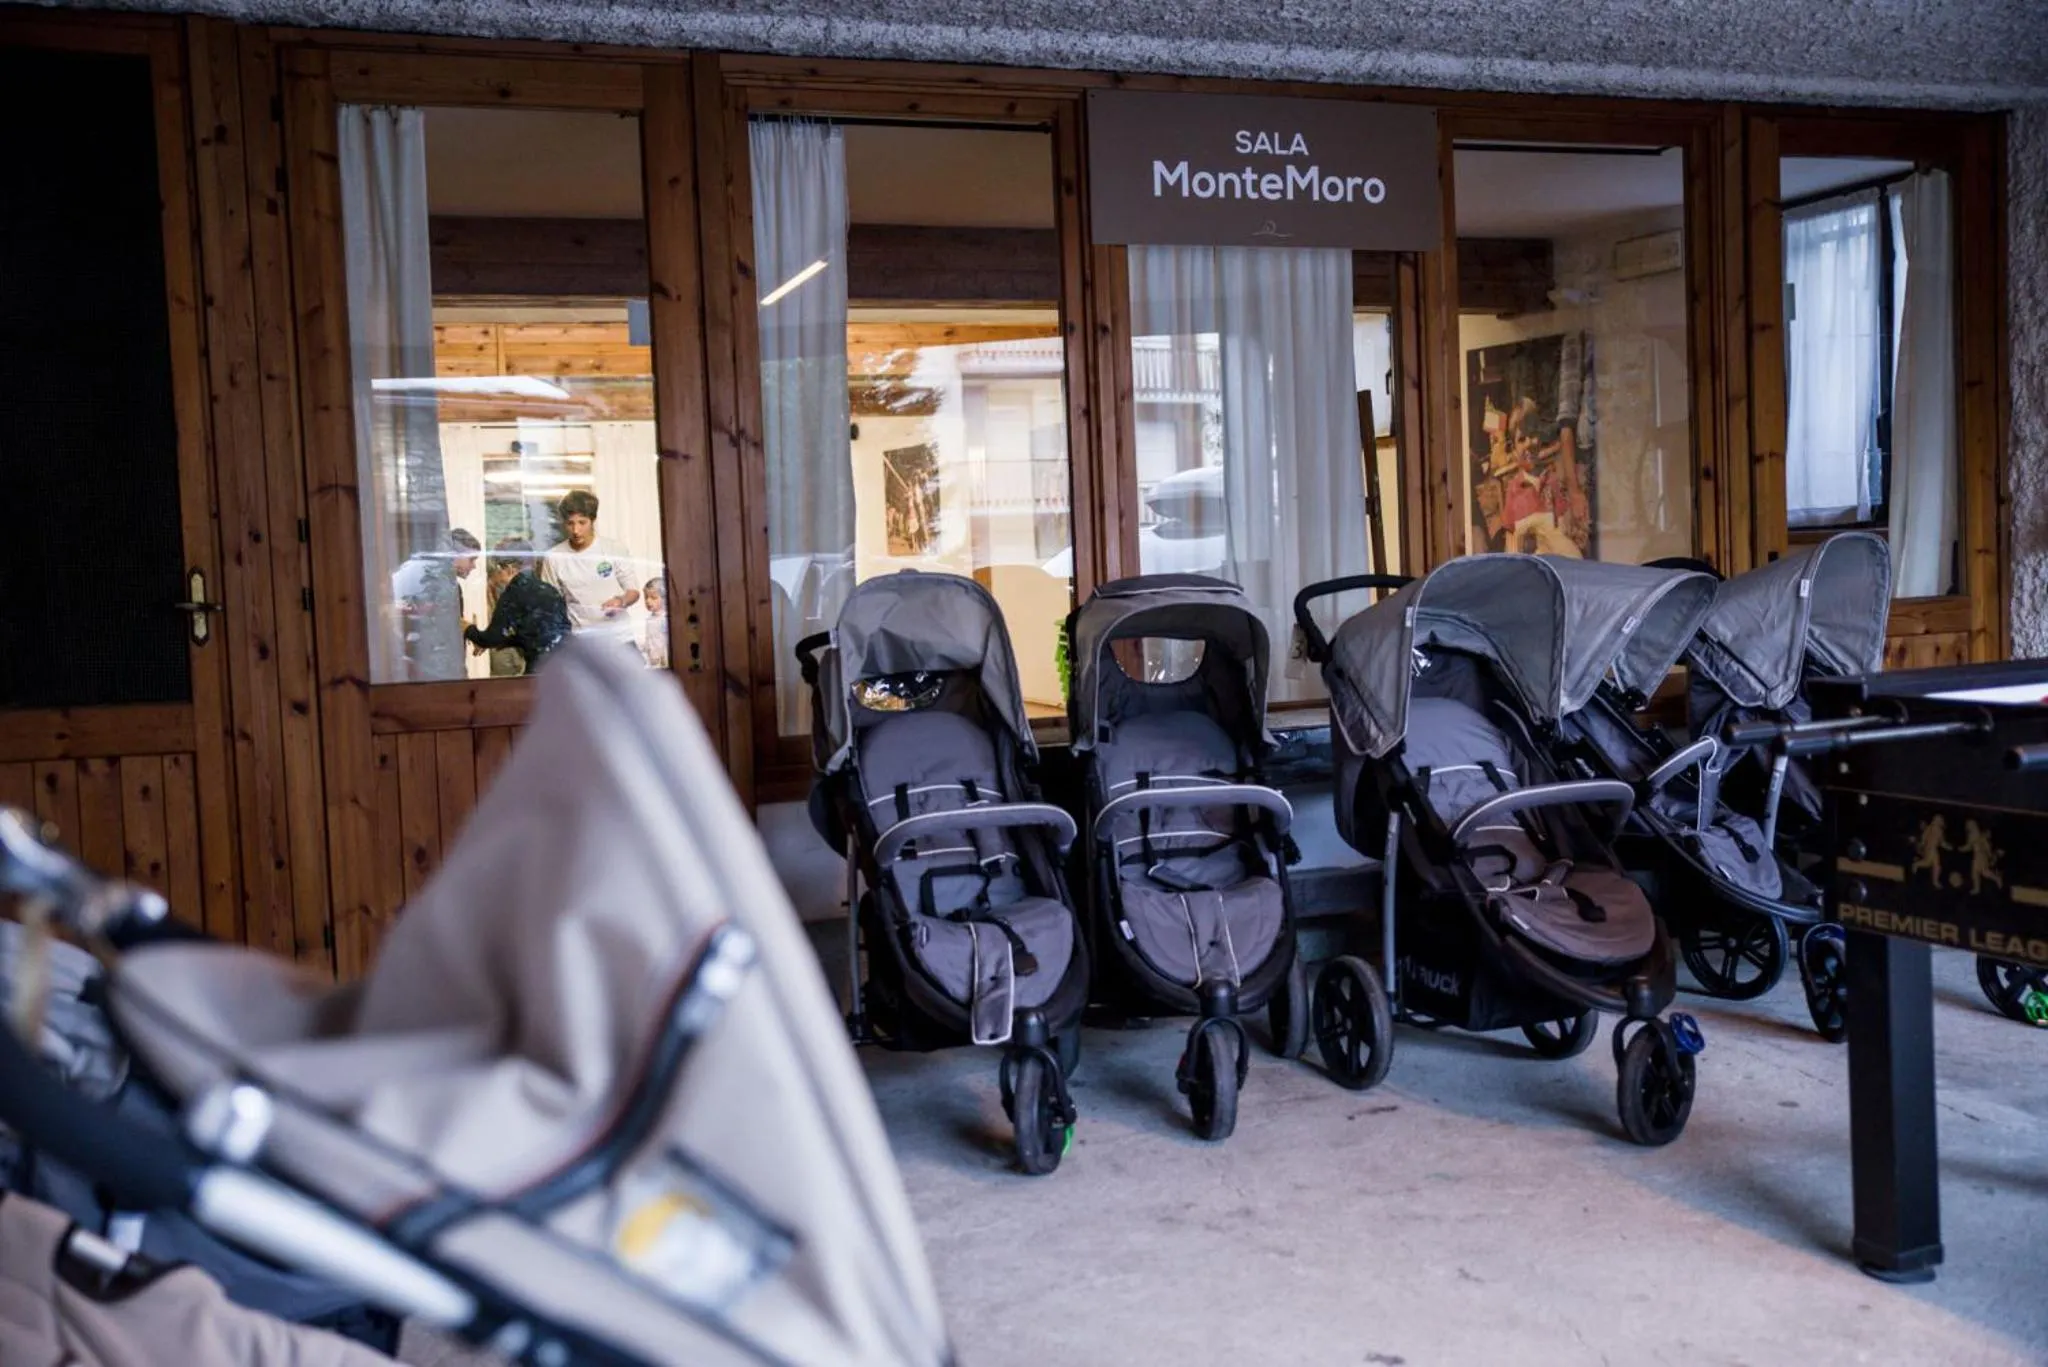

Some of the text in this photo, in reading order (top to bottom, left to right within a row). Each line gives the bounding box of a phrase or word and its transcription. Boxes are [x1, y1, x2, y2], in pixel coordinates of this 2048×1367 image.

[1235, 130, 1309, 156] SALA
[1153, 160, 1386, 204] MonteMoro
[1837, 902, 1960, 943] PREMIER
